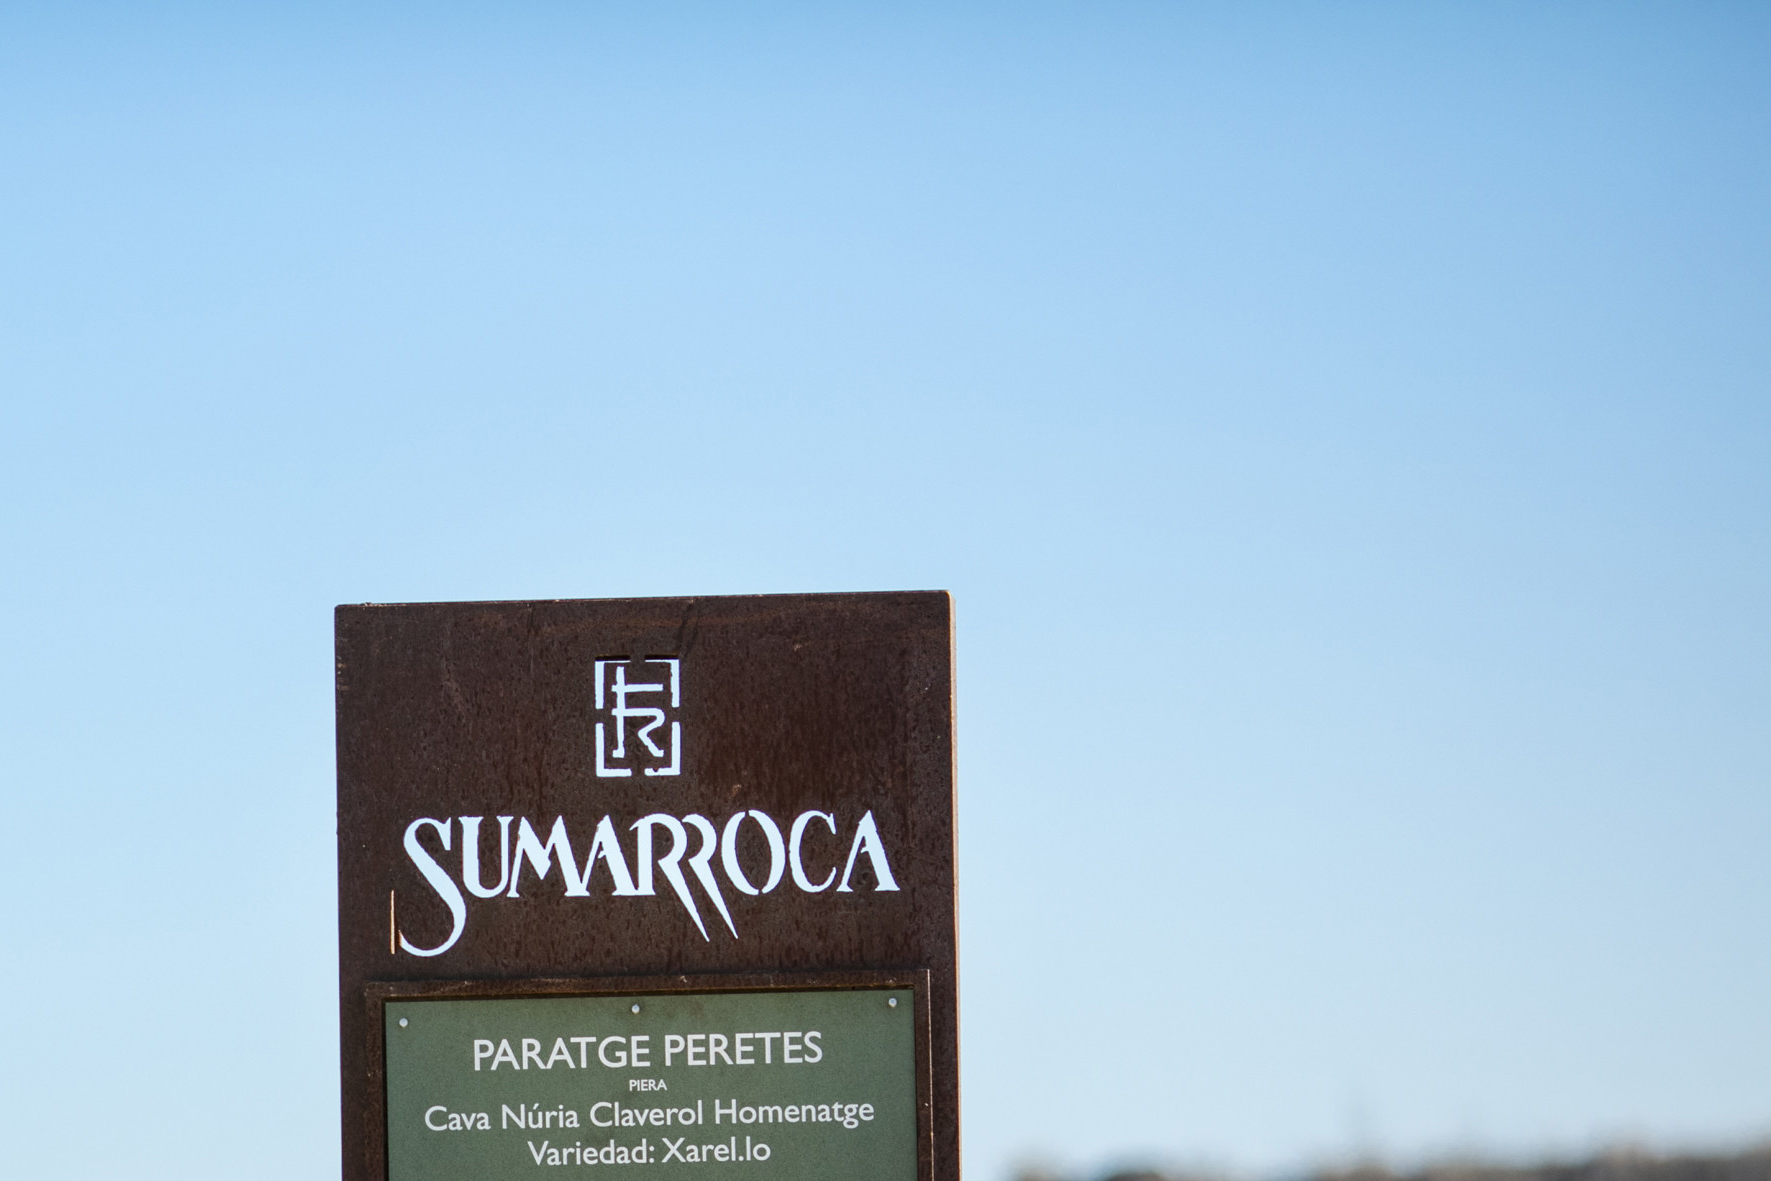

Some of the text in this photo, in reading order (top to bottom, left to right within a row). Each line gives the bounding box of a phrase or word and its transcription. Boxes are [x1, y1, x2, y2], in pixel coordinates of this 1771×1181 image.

[399, 810, 901, 957] SUMARROCA
[473, 1031, 823, 1071] PARATGE PERETES
[629, 1079, 668, 1092] PIERA
[424, 1098, 874, 1131] Cava Núria Claverol Homenatge
[527, 1135, 771, 1166] Variedad: Xarel.lo
